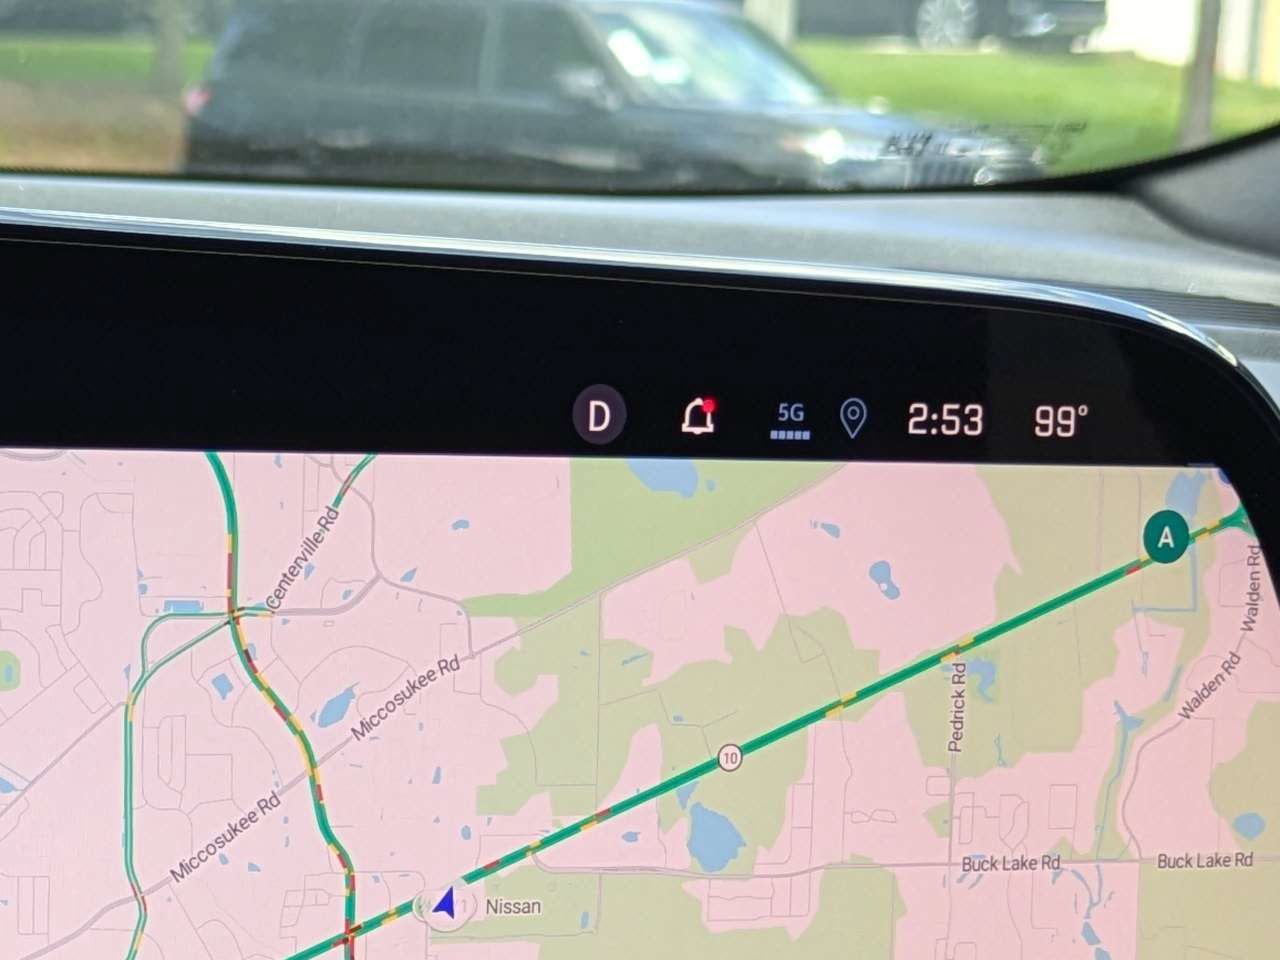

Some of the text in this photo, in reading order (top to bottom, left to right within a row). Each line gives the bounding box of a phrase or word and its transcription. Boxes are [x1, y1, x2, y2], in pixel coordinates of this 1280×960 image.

[589, 400, 610, 431] D
[778, 403, 804, 421] 5G
[908, 403, 983, 436] 2:53
[1034, 404, 1089, 437] 99°
[1157, 526, 1174, 548] A
[266, 506, 339, 614] Centerville Rd
[1240, 545, 1262, 632] Walden Rd
[351, 654, 460, 741] Miccosukee Rd
[1178, 650, 1241, 720] Walden Rd
[948, 662, 966, 752] Pedrick Rd
[724, 752, 738, 764] 10
[170, 791, 282, 884] Miccosukee Rd
[962, 855, 1060, 871] Buck Lake Rd
[1158, 852, 1253, 869] Buck Lake Rd
[486, 898, 541, 914] Nissan
